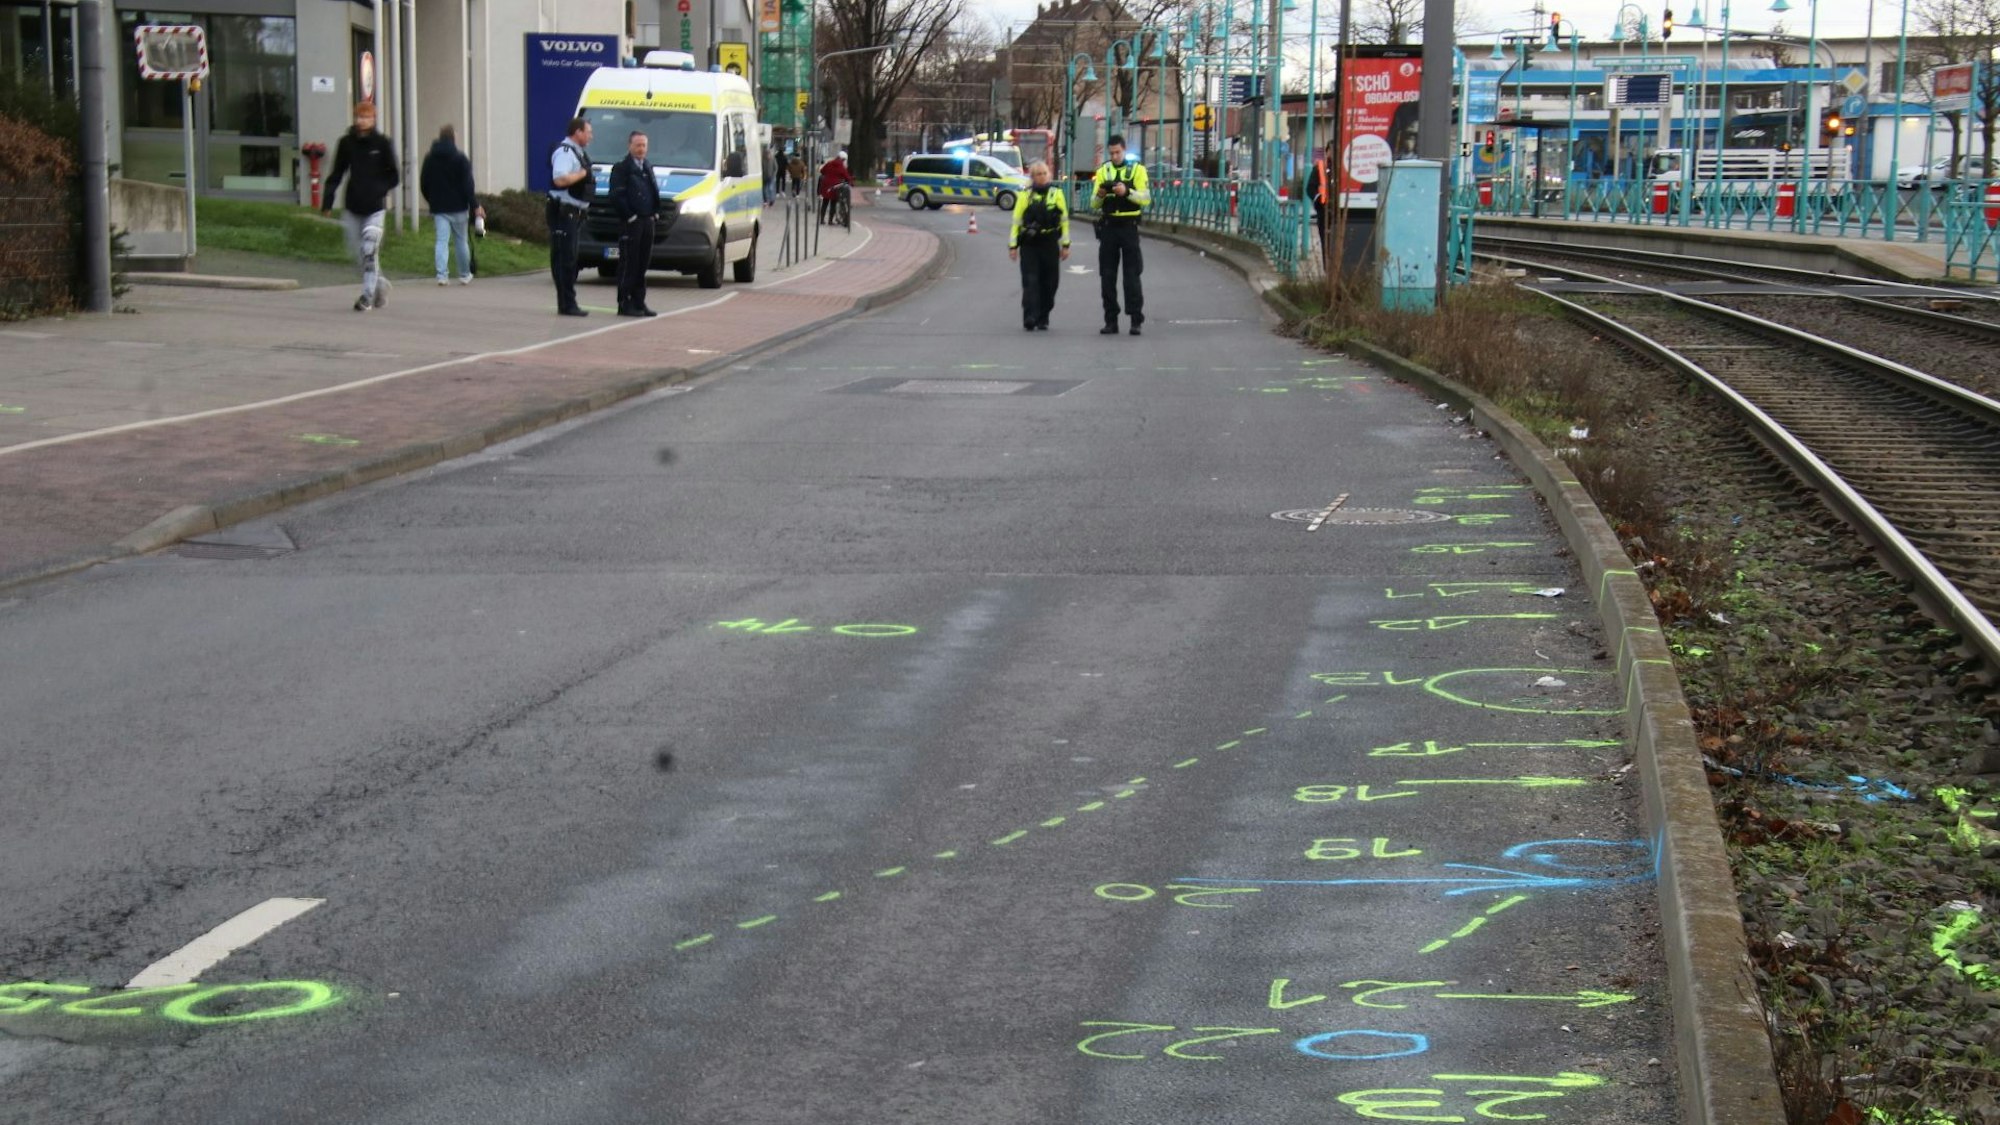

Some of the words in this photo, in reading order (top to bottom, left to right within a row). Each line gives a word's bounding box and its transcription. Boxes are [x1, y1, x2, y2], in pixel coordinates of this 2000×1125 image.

[540, 40, 605, 52] VOLVO
[542, 59, 559, 67] Volvo
[560, 59, 573, 67] Car
[599, 98, 698, 110] UNFALLAUFNAHME
[1294, 783, 1420, 804] 18
[1304, 836, 1423, 861] 19
[1093, 883, 1262, 908] 20
[1267, 978, 1447, 1010] 21
[1076, 1020, 1281, 1060] 22
[1337, 1088, 1566, 1124] 23
